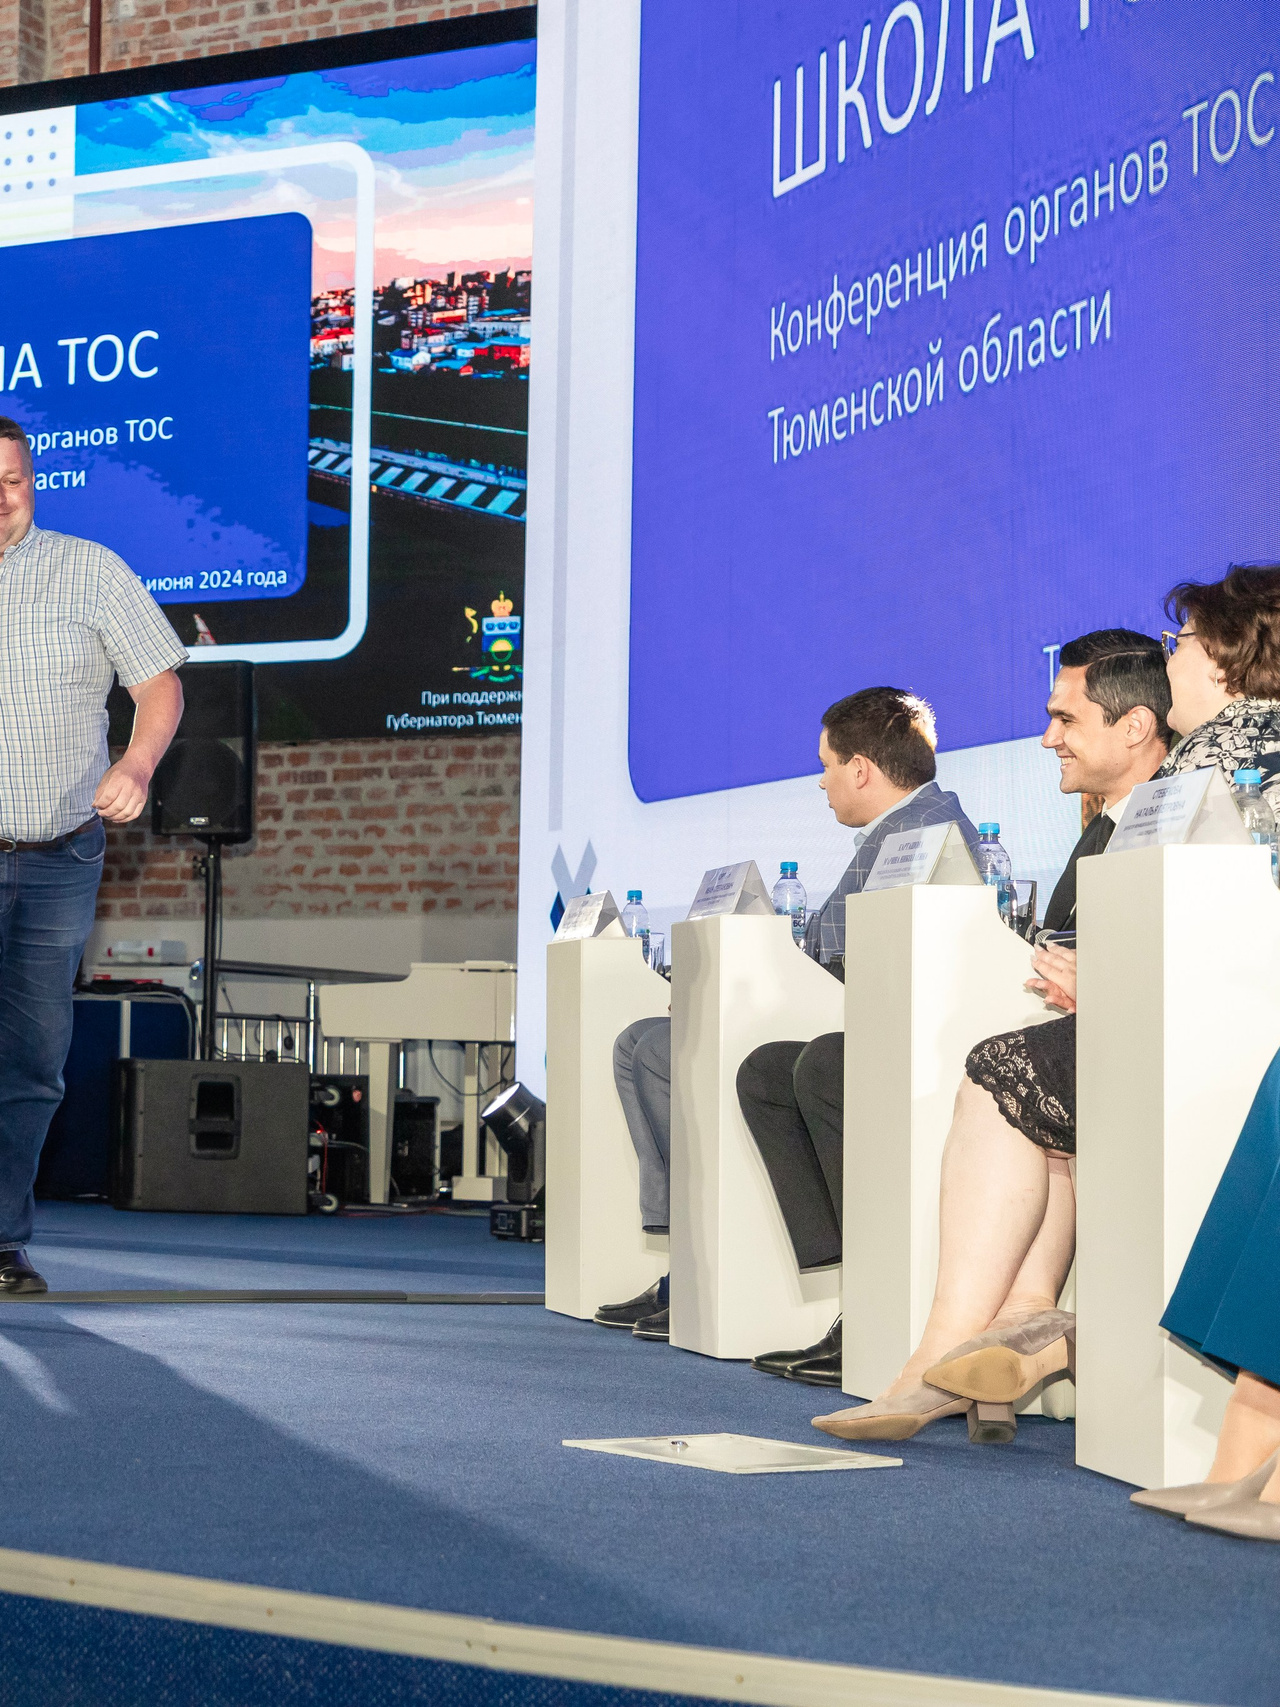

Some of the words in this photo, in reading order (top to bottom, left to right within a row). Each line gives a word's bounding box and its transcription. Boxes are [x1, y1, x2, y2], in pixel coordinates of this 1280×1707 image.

[772, 0, 1035, 198] ШКОЛА
[770, 222, 987, 362] Конференция
[1003, 139, 1169, 263] органов
[1182, 71, 1275, 175] ТОС
[58, 329, 159, 385] ТОС
[767, 338, 943, 464] Тюменской
[957, 289, 1111, 393] области
[125, 416, 174, 442] ТОС
[35, 469, 86, 491] асти
[146, 575, 194, 591] июня
[199, 569, 243, 589] 2024
[247, 570, 288, 588] года
[422, 690, 450, 707] При
[452, 689, 522, 706] поддерж
[386, 712, 474, 731] Губернатора
[476, 711, 523, 725] Тюмен
